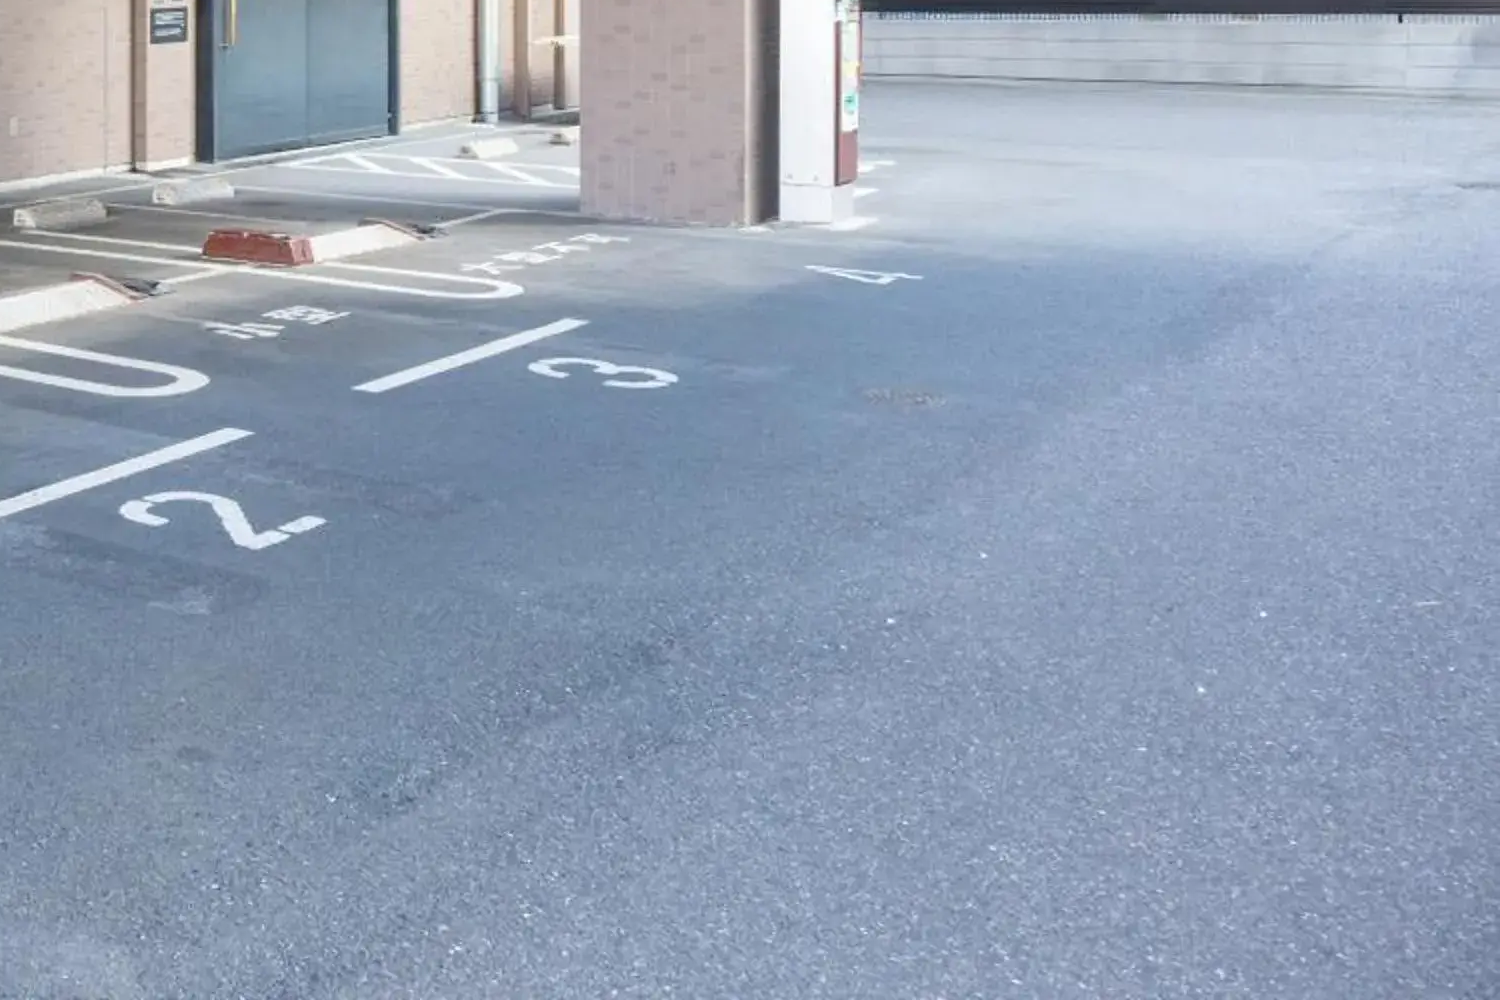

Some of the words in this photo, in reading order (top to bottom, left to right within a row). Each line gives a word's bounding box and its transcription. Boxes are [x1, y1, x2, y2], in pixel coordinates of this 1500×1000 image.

[803, 264, 924, 285] 4
[204, 305, 351, 340] 小型
[527, 356, 679, 390] 3
[119, 489, 327, 551] 2
